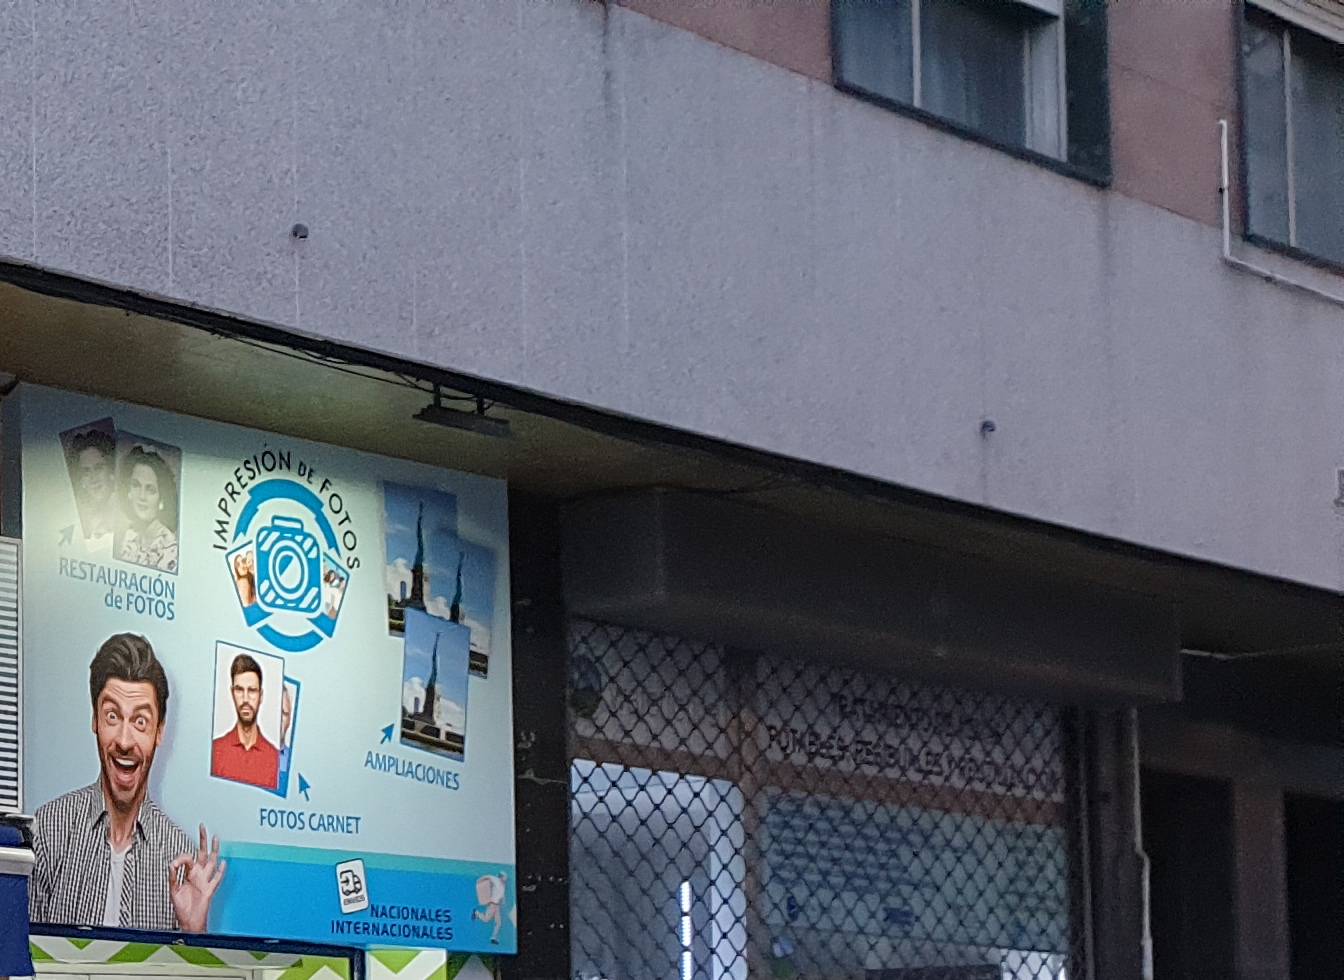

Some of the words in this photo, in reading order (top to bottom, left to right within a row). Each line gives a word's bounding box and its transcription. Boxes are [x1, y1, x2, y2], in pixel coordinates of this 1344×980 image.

[212, 442, 292, 551] IMPRESIÓN
[297, 460, 316, 485] DE
[319, 477, 360, 570] FOTOS
[58, 556, 176, 599] RESTAURACIÓN
[104, 588, 124, 610] de
[125, 591, 176, 621] FOTOS
[364, 750, 461, 791] AMPLIACIONES
[259, 808, 305, 831] FOTOS
[308, 811, 361, 836] CARNET
[331, 920, 454, 941] INTERNACIONALES
[370, 904, 453, 924] NACIONALES
